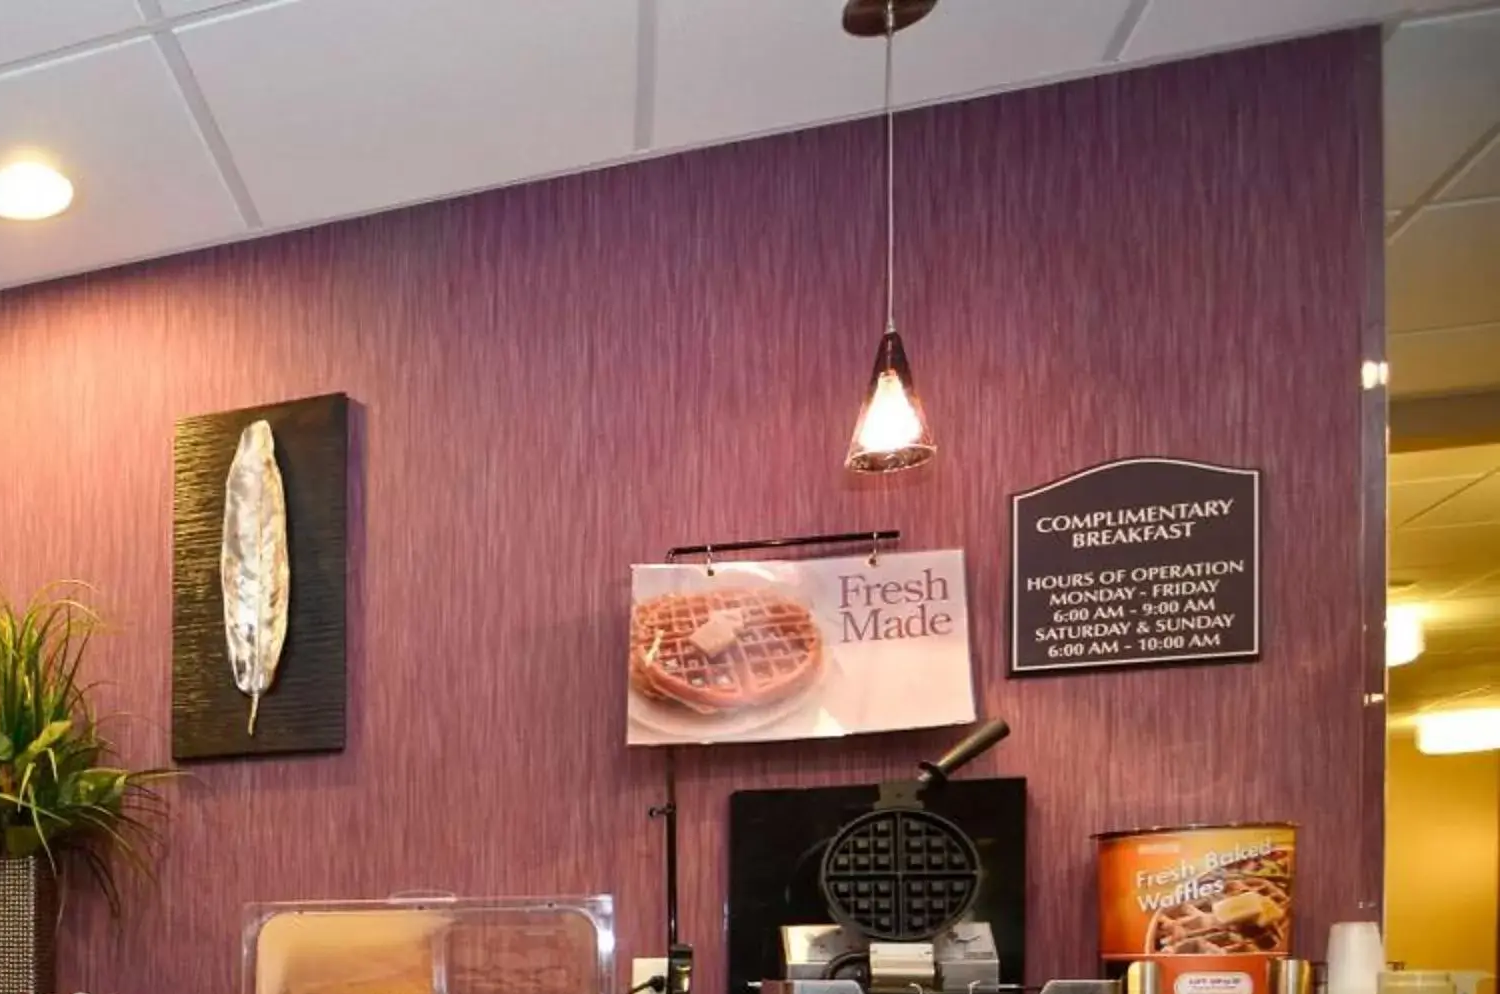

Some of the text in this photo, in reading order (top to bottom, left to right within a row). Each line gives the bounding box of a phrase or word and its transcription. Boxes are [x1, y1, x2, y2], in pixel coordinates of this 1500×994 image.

[1036, 498, 1234, 533] COMPLIMENTARY
[1072, 521, 1197, 549] BREAKFAST
[838, 568, 949, 609] Fresh
[1027, 560, 1244, 591] HOURS OF OPERATION
[1049, 587, 1137, 606] MONDAY
[1152, 579, 1220, 598] FRIDAY
[839, 605, 952, 643] Made
[1053, 607, 1090, 623] 6:00
[1093, 605, 1125, 619] AM
[1142, 600, 1180, 616] 9:00
[1183, 597, 1216, 613] AM
[1035, 613, 1236, 642] SATURDAY & SUNDAY
[1047, 643, 1085, 658] 6:00
[1088, 640, 1120, 656] AM
[1138, 635, 1185, 651] 10:00
[1188, 633, 1221, 648] AM
[1136, 837, 1272, 889] Fresh Baked
[1136, 878, 1225, 913] Waffles
